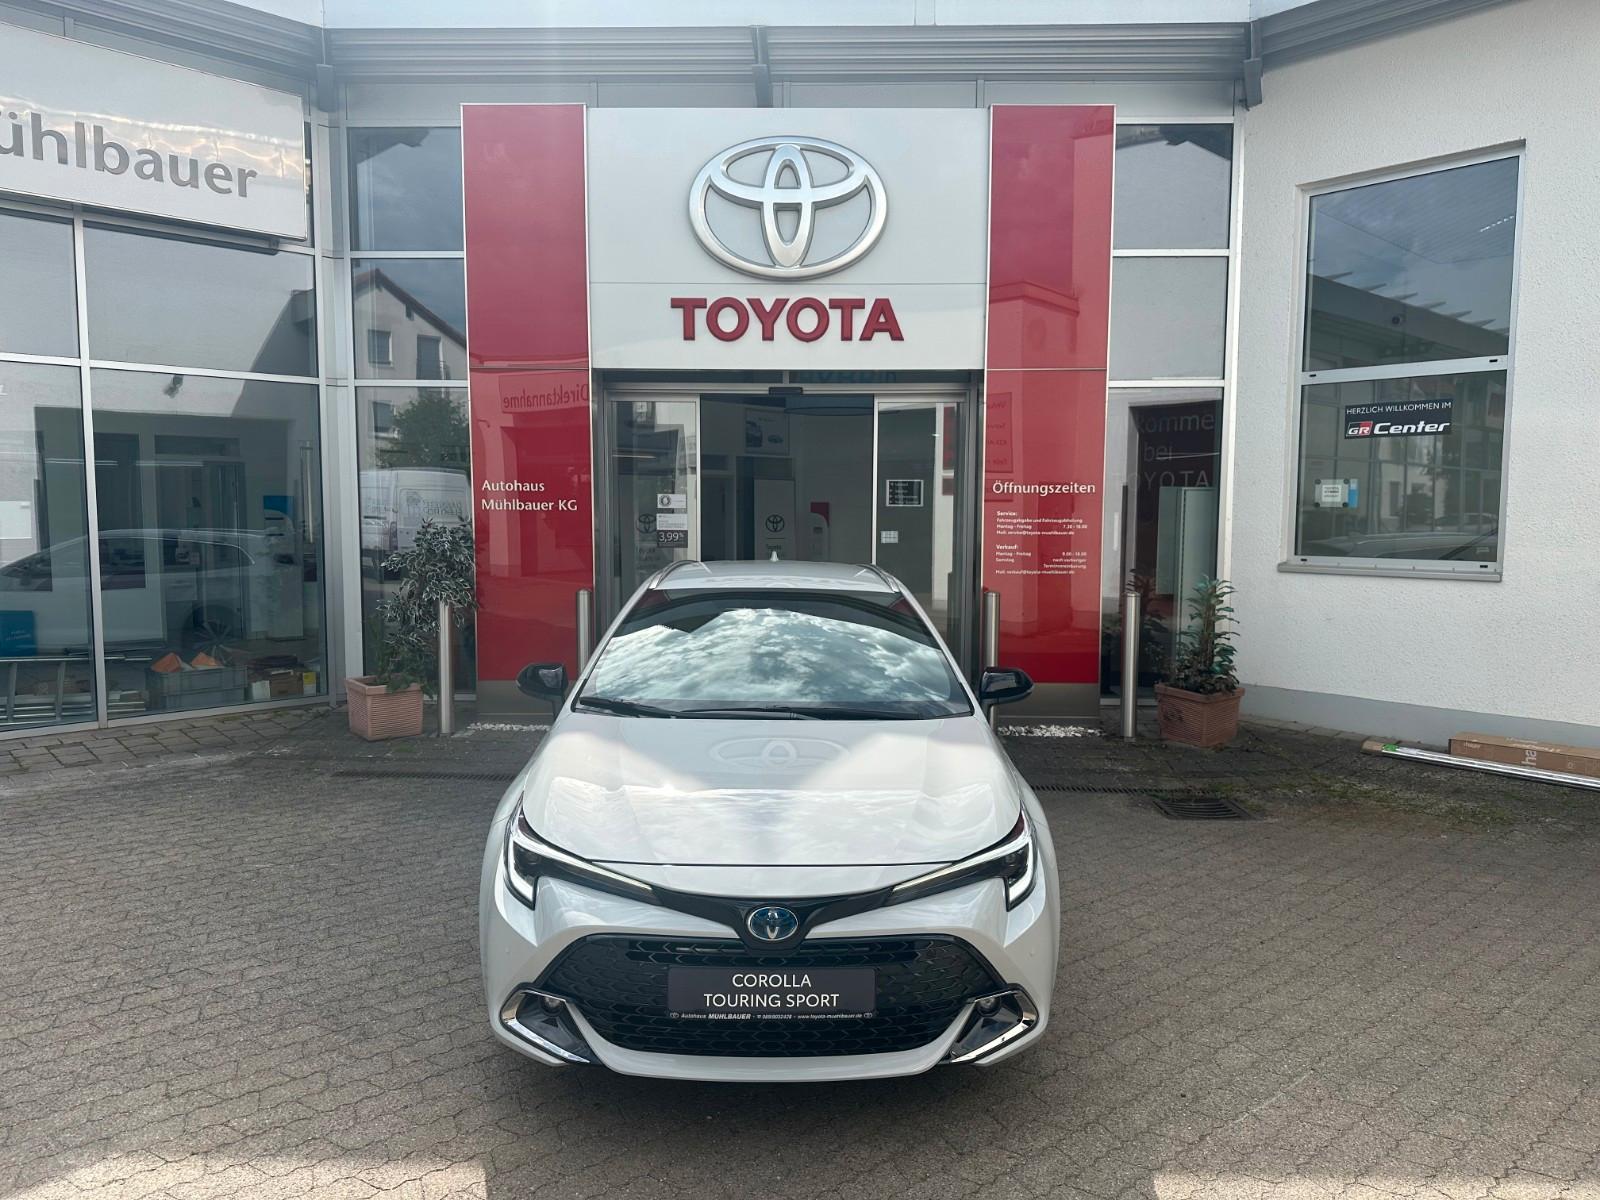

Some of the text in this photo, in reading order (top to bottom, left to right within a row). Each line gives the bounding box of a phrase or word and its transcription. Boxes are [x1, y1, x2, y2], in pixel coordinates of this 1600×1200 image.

[670, 296, 904, 343] TOYOTA
[1346, 401, 1452, 415] HERZLICH WILLKOMMEN IM
[1348, 420, 1451, 435] GR Center
[482, 480, 545, 492] Autohaus
[992, 480, 1096, 497] Öffnungszeiten
[481, 498, 578, 511] Mühlbauer KG
[731, 973, 812, 988] COROLLA
[703, 993, 840, 1008] TOURING SPORT
